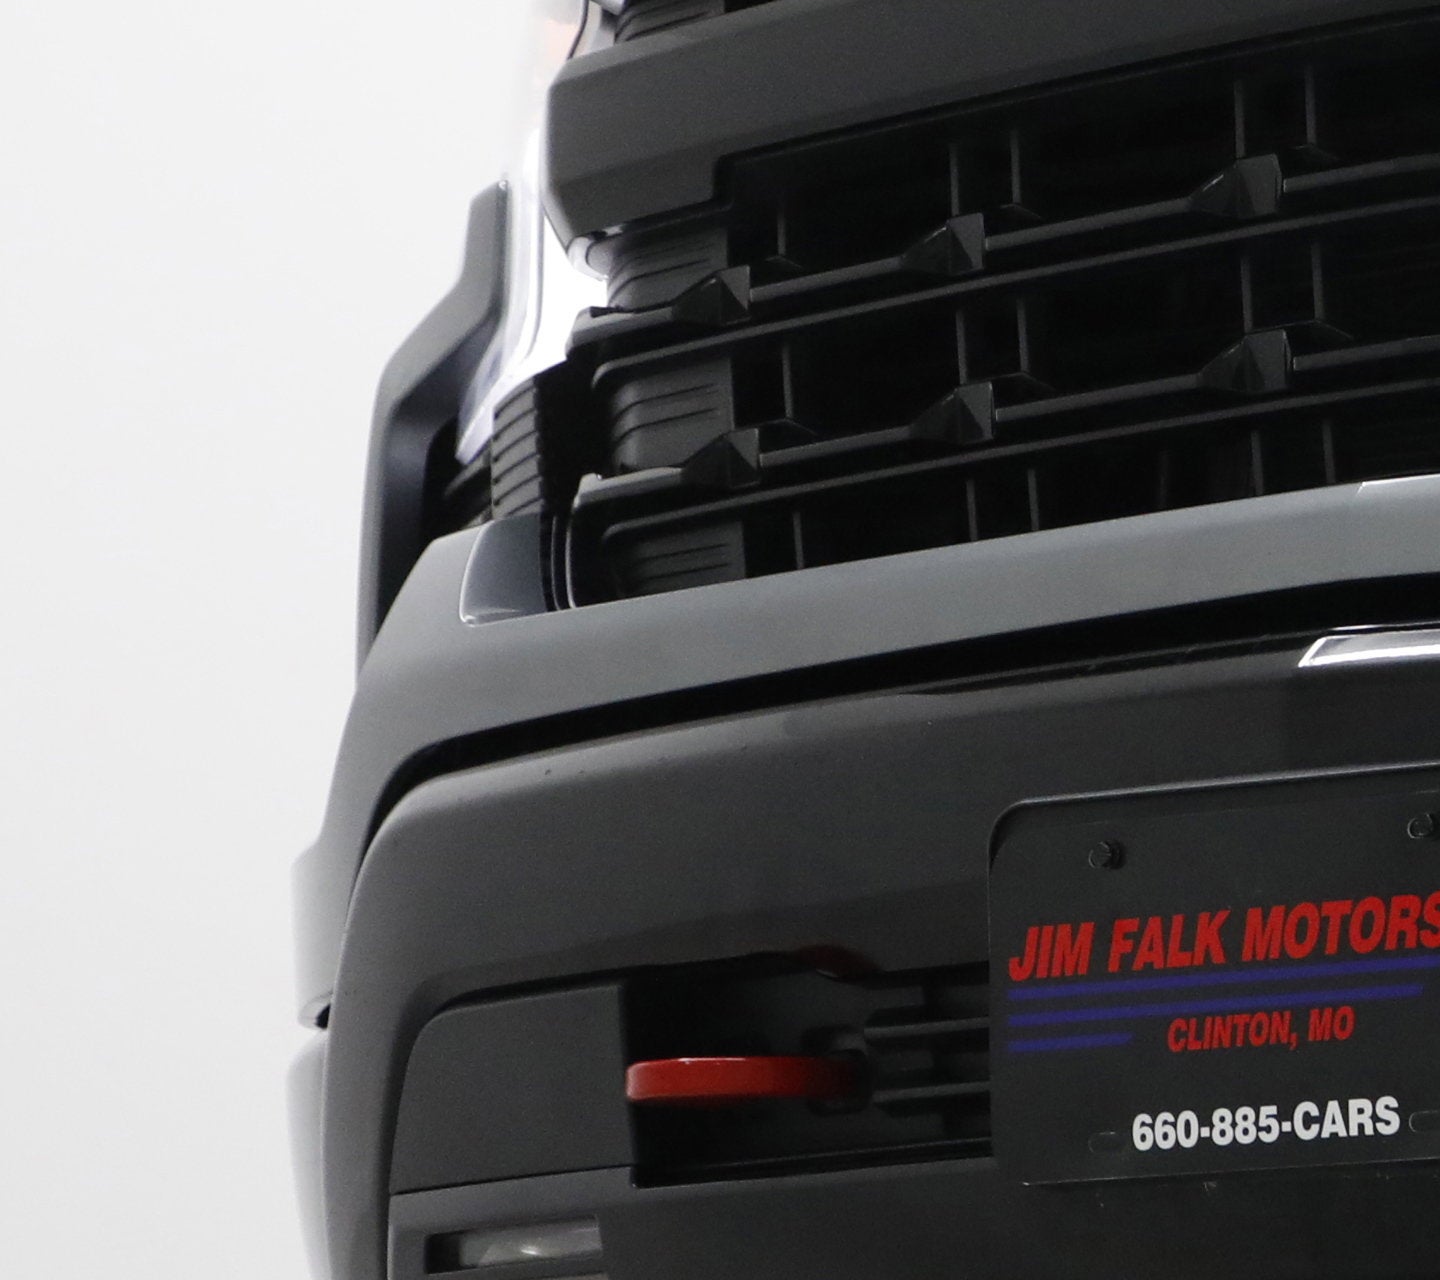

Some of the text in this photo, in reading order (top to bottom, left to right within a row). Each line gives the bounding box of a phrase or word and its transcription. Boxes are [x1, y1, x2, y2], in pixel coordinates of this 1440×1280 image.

[1007, 921, 1096, 982] JIM
[1107, 909, 1232, 973] FALK
[1167, 1005, 1356, 1053] CLINTON, MO
[1132, 1095, 1401, 1151] 660-885-CARS
